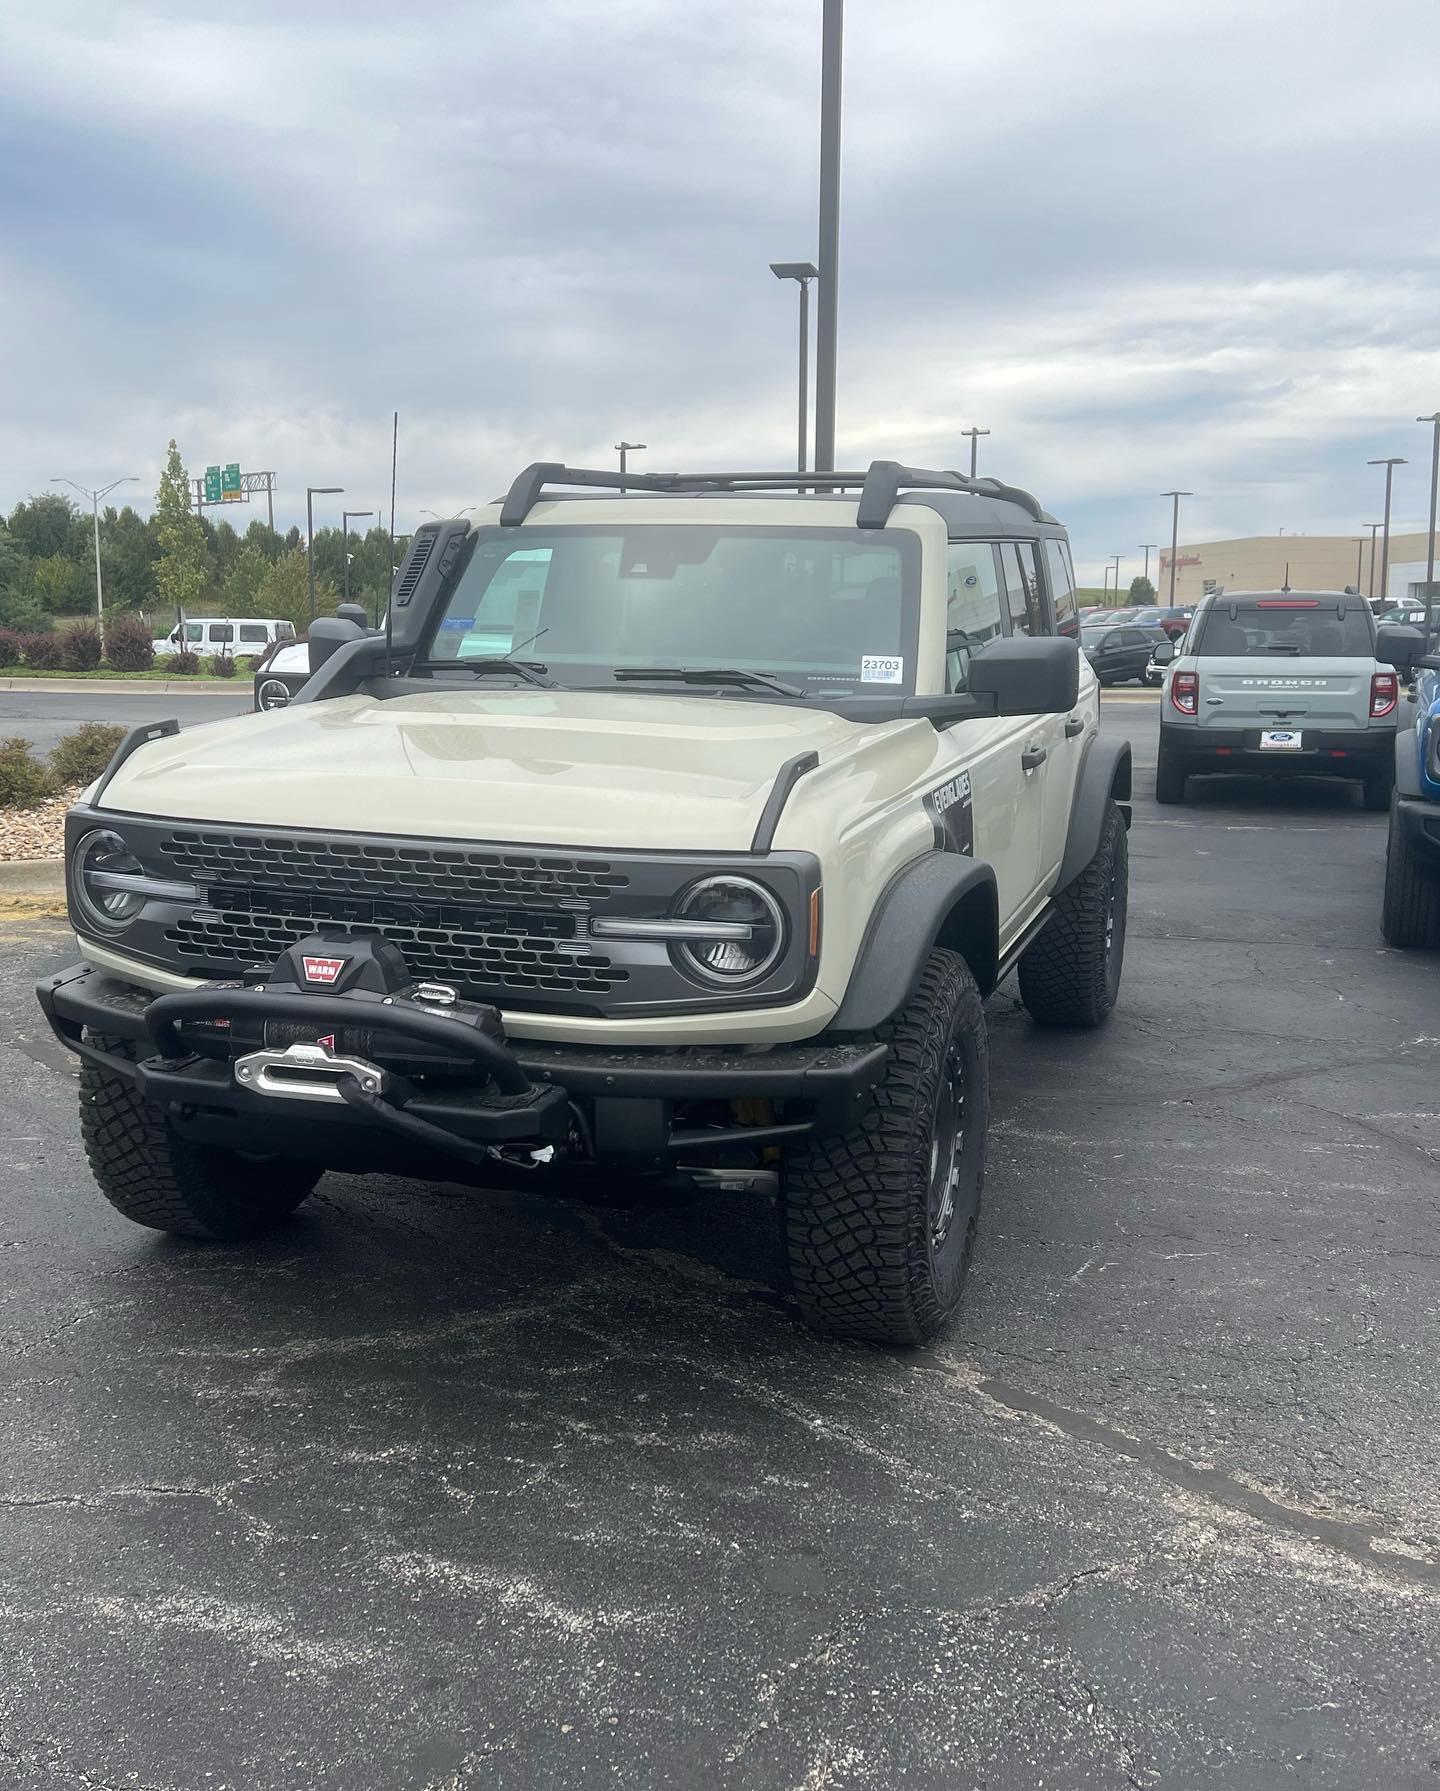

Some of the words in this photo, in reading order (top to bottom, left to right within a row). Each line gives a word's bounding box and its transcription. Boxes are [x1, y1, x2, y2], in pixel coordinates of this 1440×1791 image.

[863, 660, 900, 671] 23703
[933, 772, 970, 814] EVERGLADES
[307, 964, 336, 976] WARN
